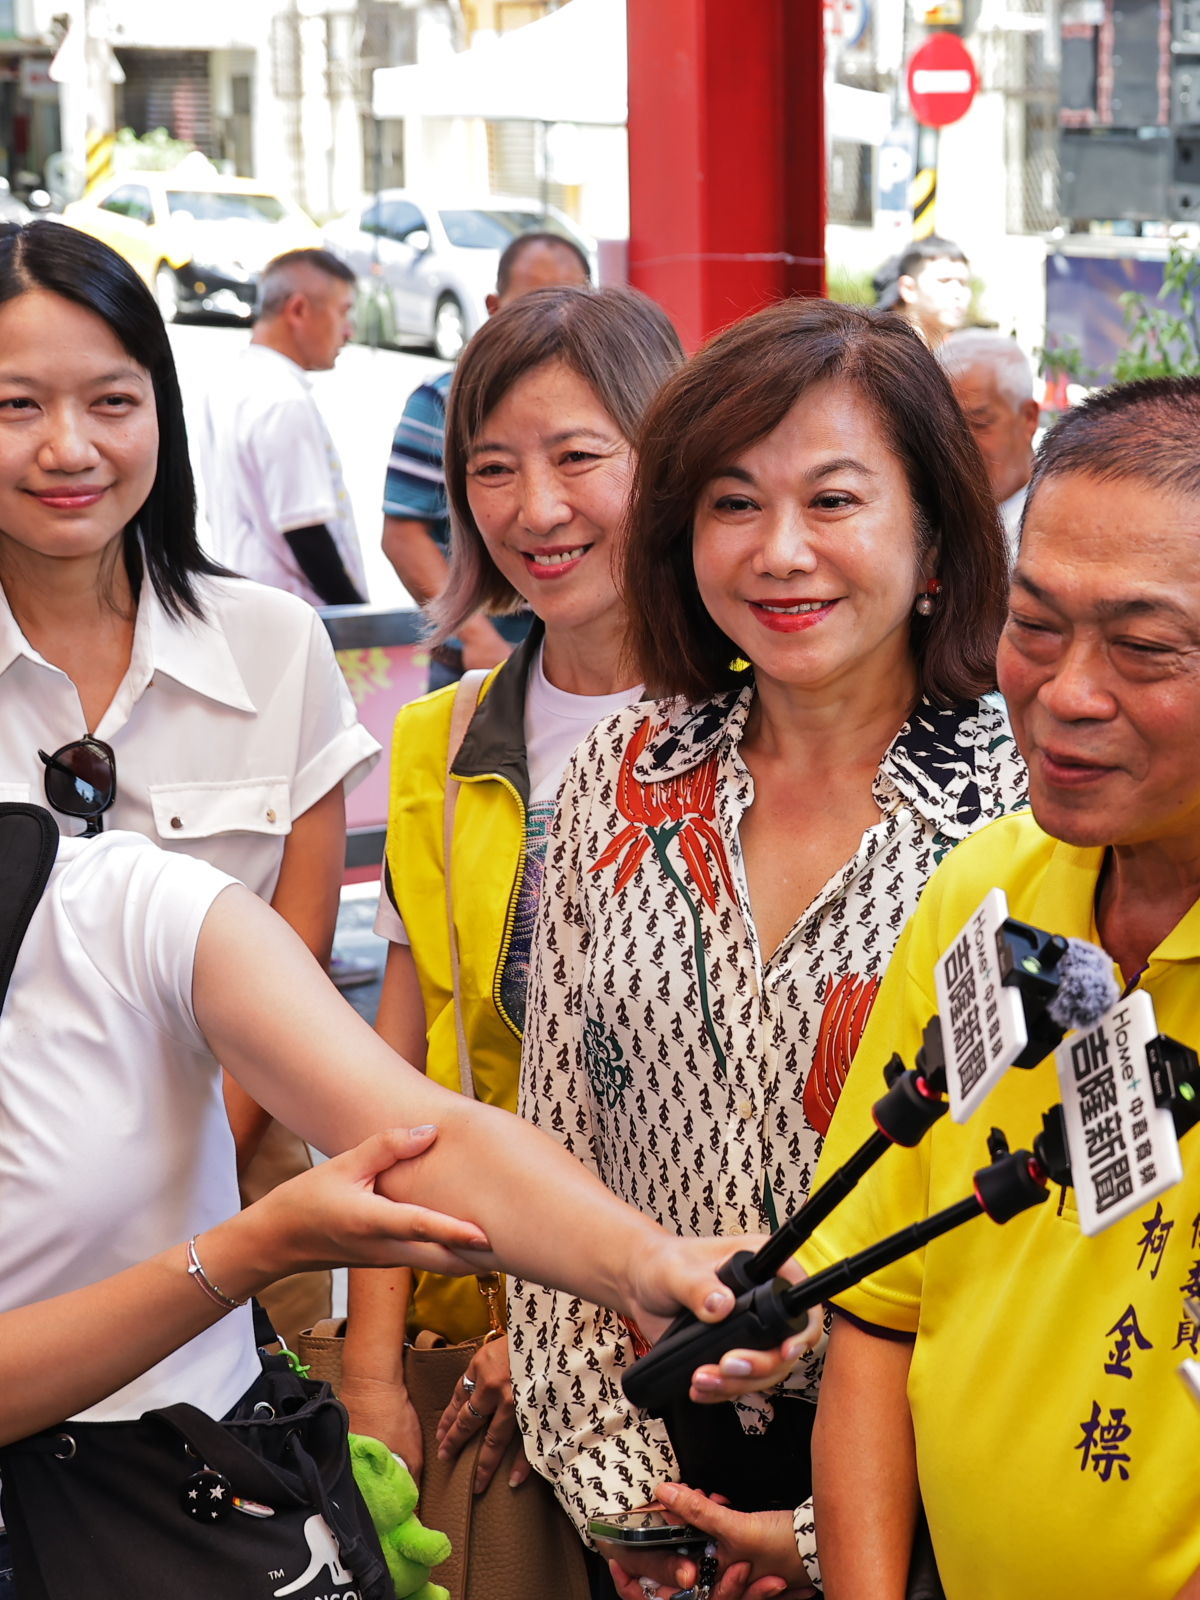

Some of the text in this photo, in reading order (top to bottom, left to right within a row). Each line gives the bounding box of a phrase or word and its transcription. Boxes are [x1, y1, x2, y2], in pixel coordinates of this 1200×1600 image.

[1112, 1007, 1142, 1092] Home+
[1070, 1025, 1134, 1214] 吉隆新聞
[1074, 1201, 1175, 1482] 柯金標
[267, 1568, 286, 1580] TM
